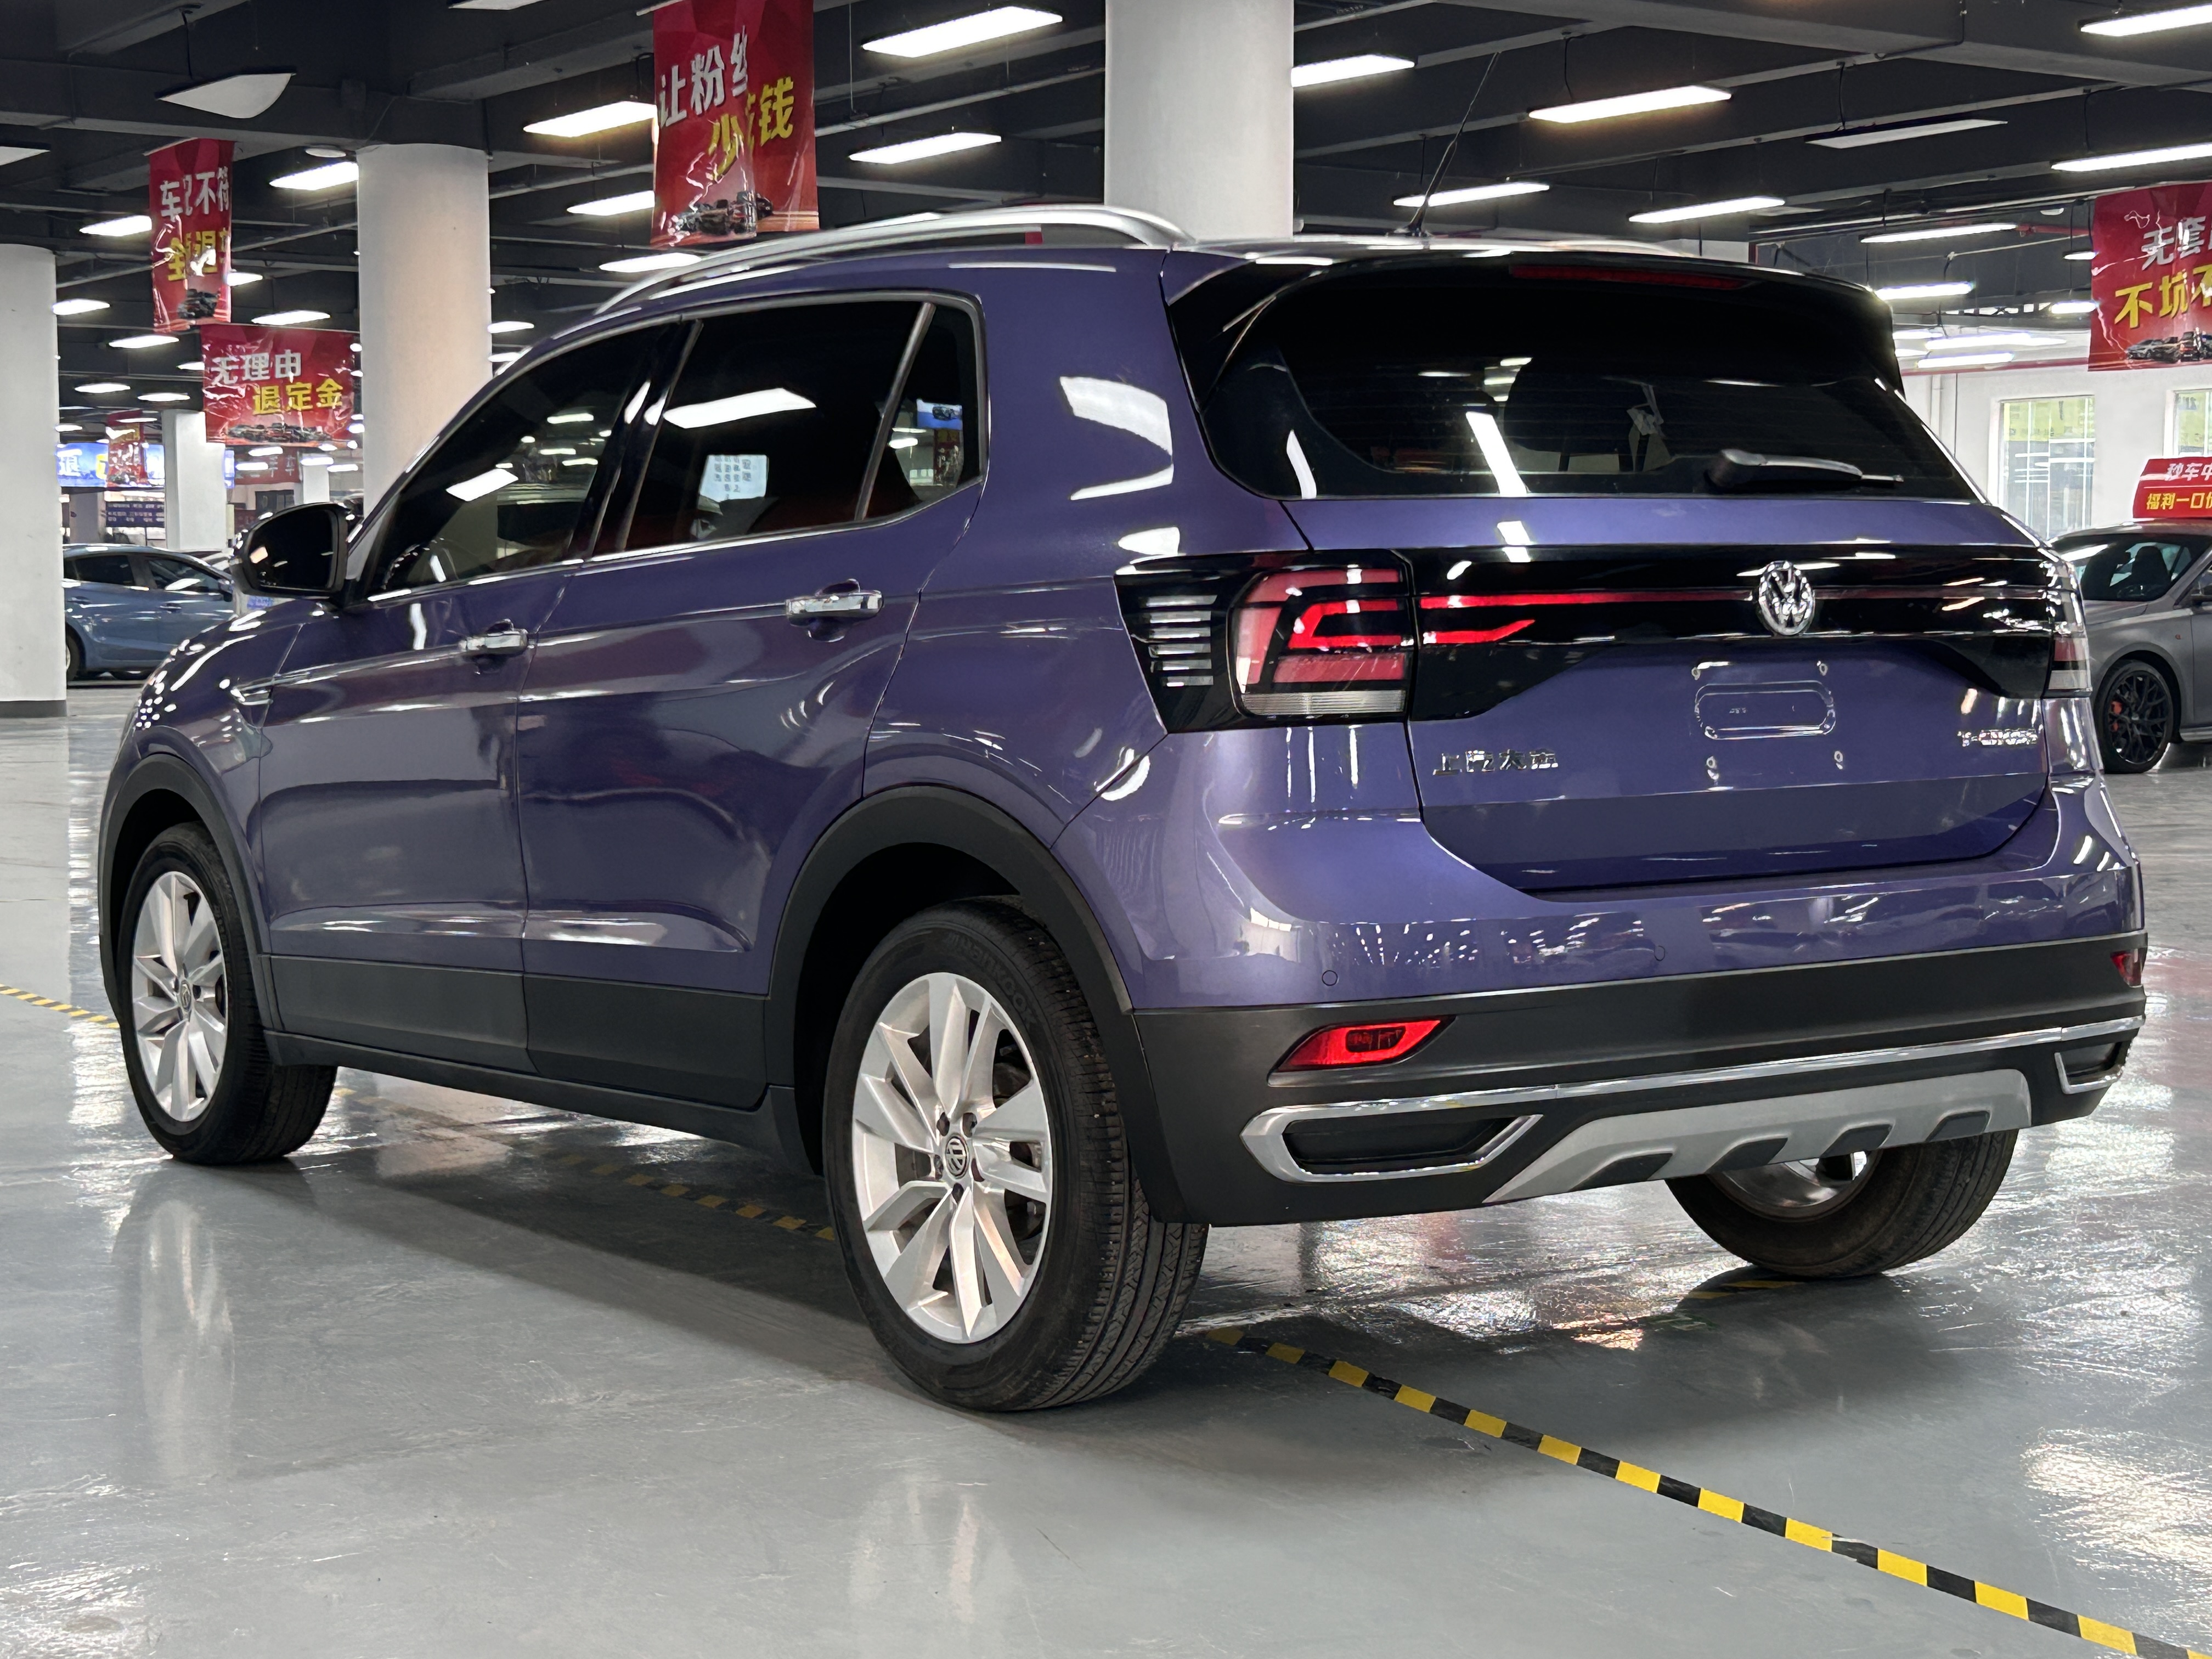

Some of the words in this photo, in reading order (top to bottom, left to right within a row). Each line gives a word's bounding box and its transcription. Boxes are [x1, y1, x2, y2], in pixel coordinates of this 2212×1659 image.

[210, 349, 301, 385] 无理由
[252, 377, 343, 415] 退定金
